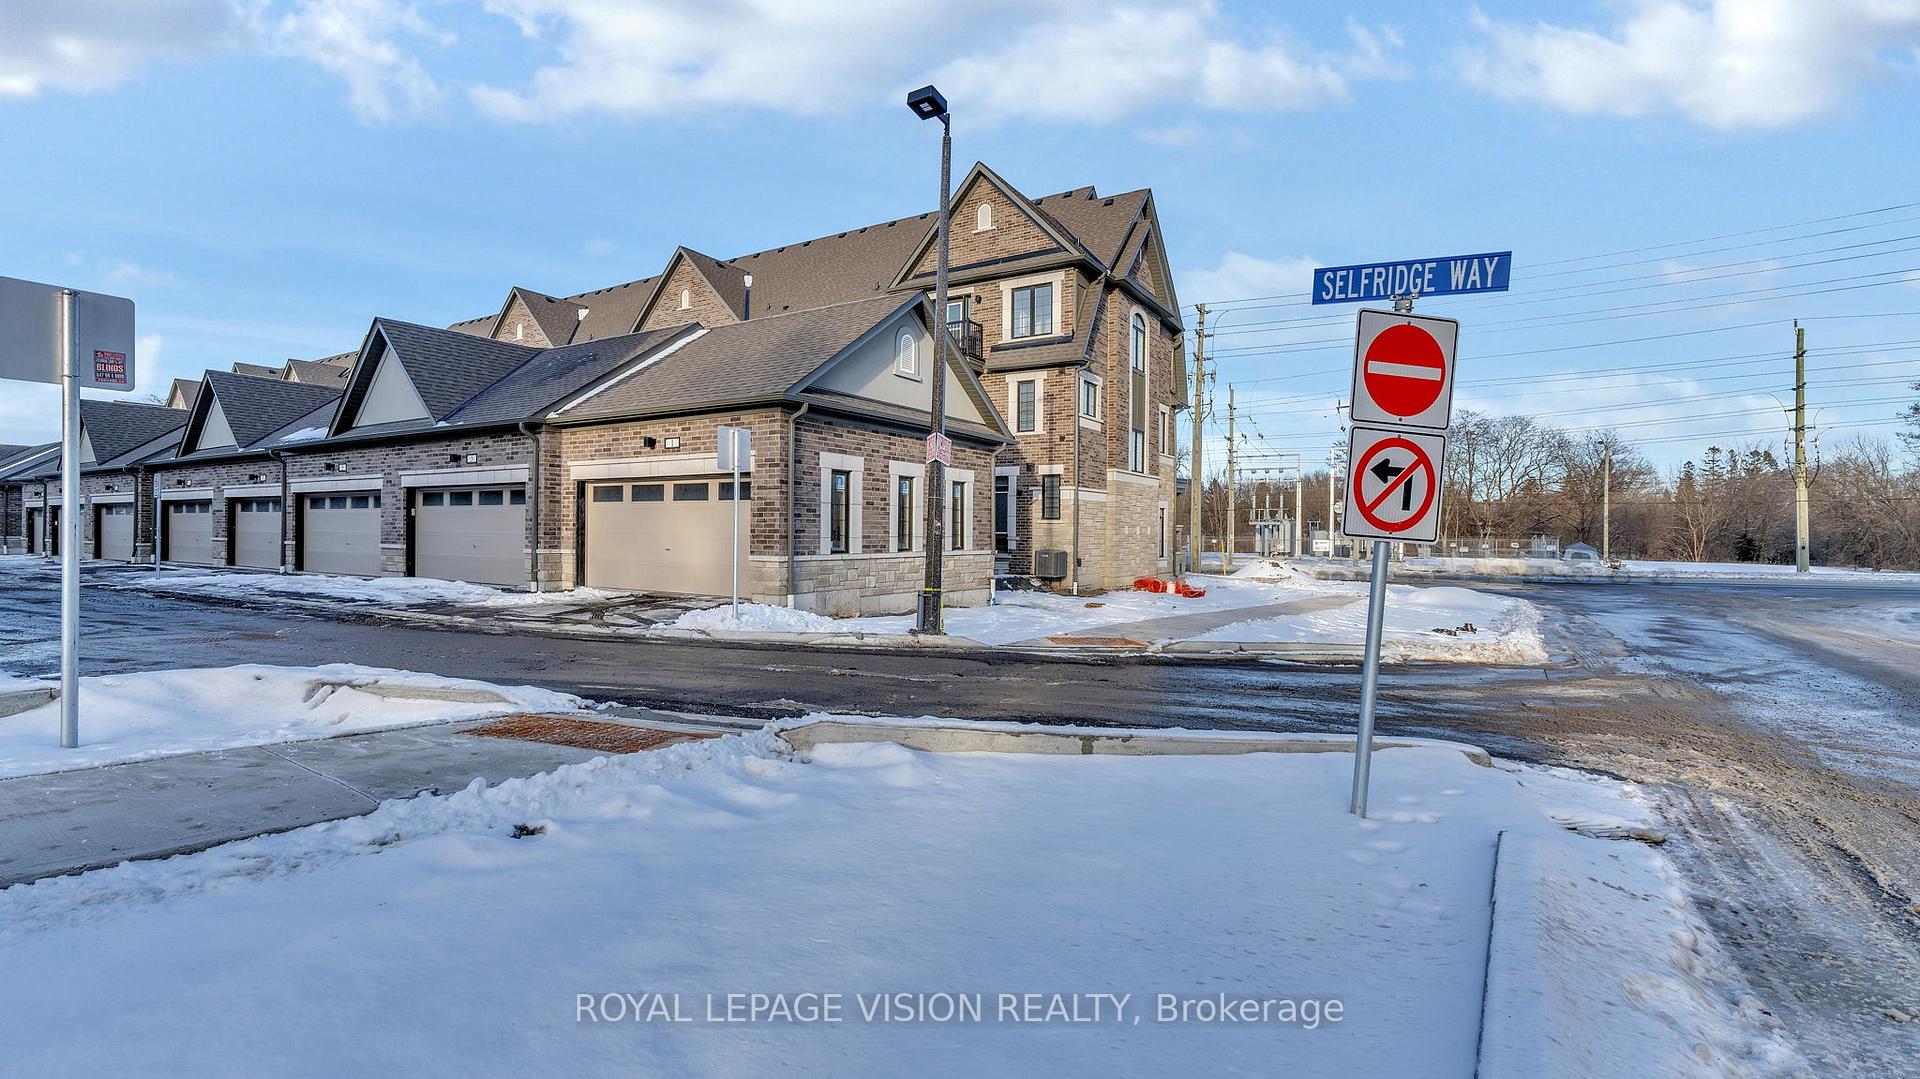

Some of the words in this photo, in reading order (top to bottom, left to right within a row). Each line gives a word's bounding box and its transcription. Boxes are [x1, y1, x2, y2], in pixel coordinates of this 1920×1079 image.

[1321, 262, 1437, 300] SELFRIDGE
[1450, 256, 1499, 290] WAY
[96, 363, 124, 373] BLINDS
